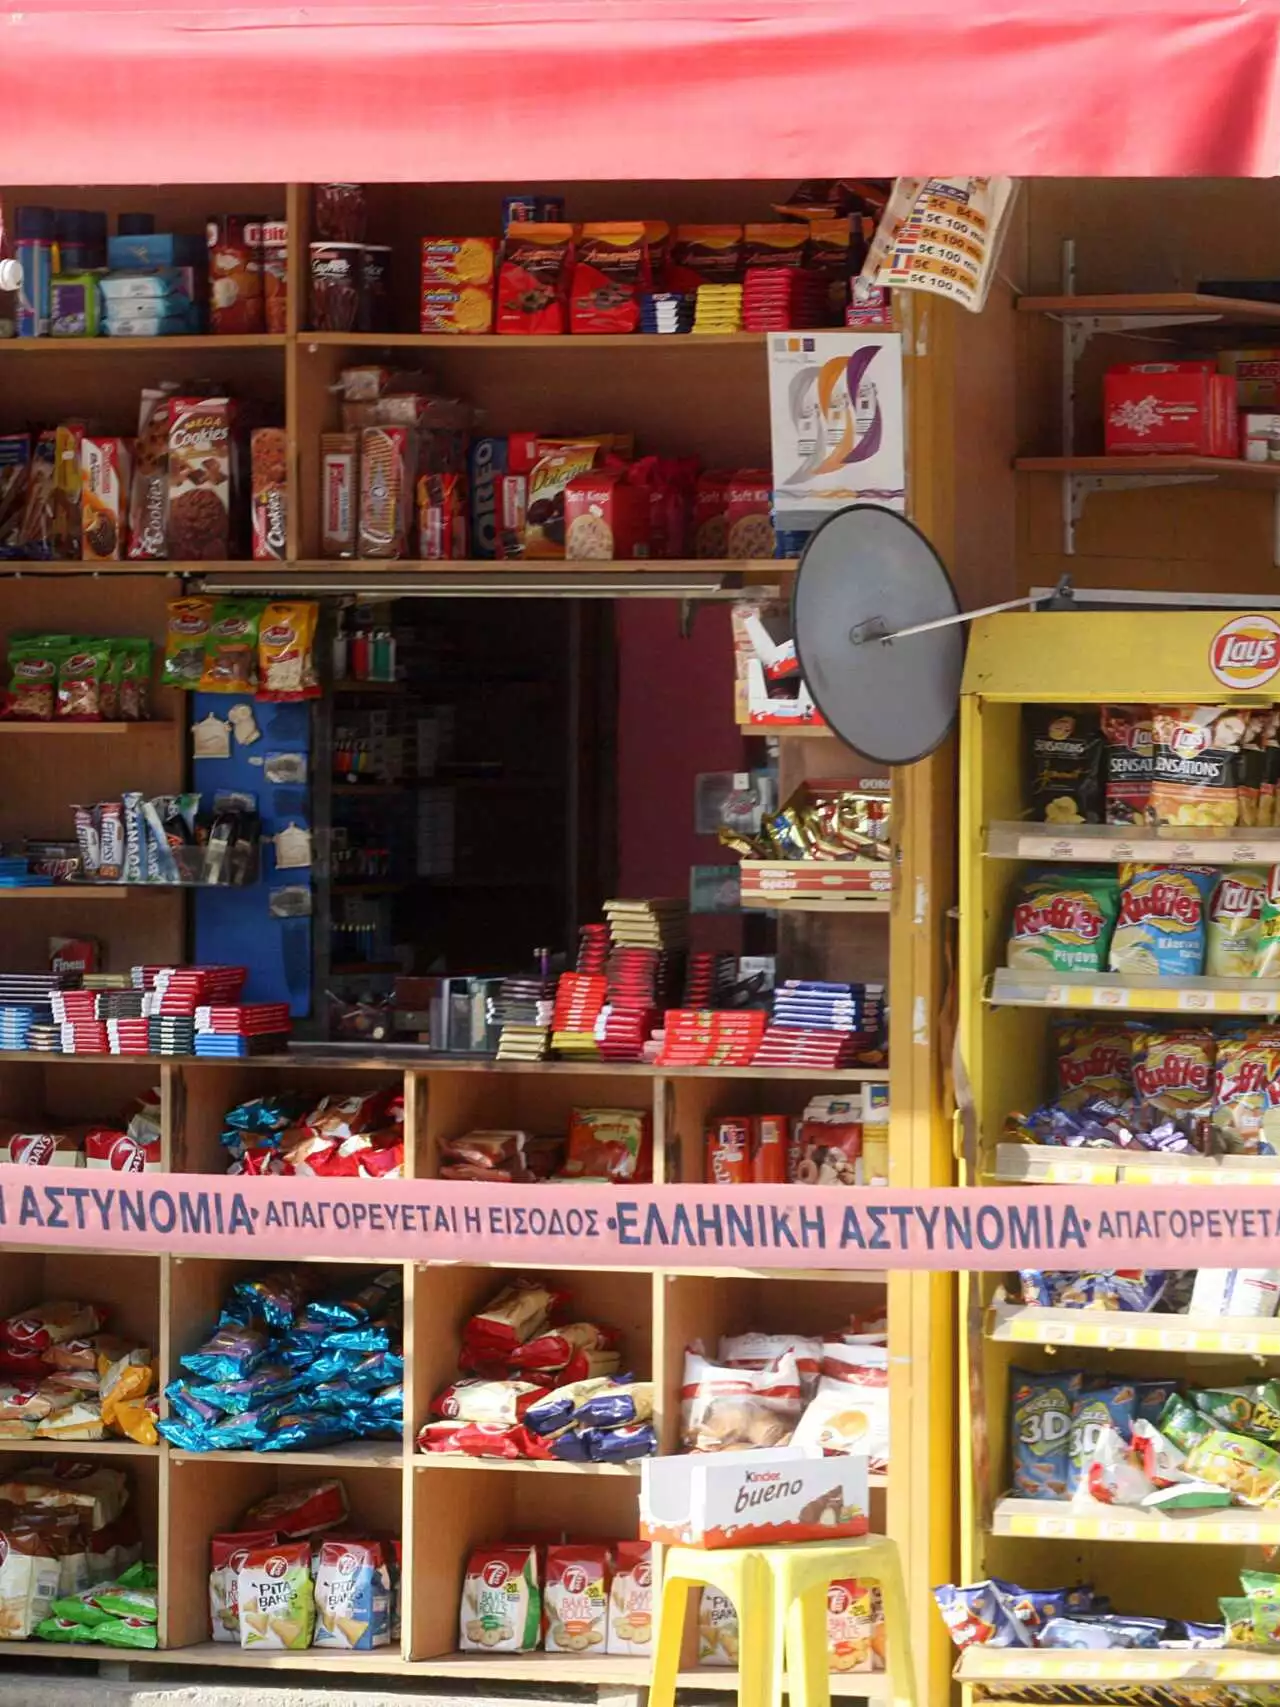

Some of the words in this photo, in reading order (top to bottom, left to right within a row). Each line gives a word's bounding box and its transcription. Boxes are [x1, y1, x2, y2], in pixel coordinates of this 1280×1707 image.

[926, 213, 943, 225] 5€
[945, 217, 968, 234] 100
[922, 229, 938, 240] 5€
[942, 232, 965, 249] 100
[914, 259, 930, 270] 5€
[918, 243, 935, 255] 5€
[938, 248, 961, 264] 100
[910, 273, 927, 284] 5€
[929, 277, 953, 291] 100
[169, 425, 228, 450] Cookies
[474, 437, 497, 551] OREO
[1217, 632, 1279, 668] Lay's
[1111, 758, 1153, 773] SENSAT
[1154, 756, 1222, 778] ENSATIONS
[1013, 896, 1106, 938] Ruffles
[1118, 882, 1202, 929] Ruffles
[19, 1184, 256, 1236] ΑΣΤΥΝΟΜΙΑ
[265, 1201, 457, 1233] ΑΠΑΓΟΡΕΥΕΤΑΙ
[465, 1206, 482, 1234] Η
[490, 1205, 600, 1236] ΕΙΣΟΔΟΣ
[616, 1202, 826, 1249] ΕΛΛΗΝΙΚΗ
[839, 1204, 1086, 1250] ΑΣΤΥΝΟΜΙΑ
[1019, 1410, 1072, 1443] 3D
[734, 1479, 804, 1514] bueno
[630, 1590, 652, 1602] BAK
